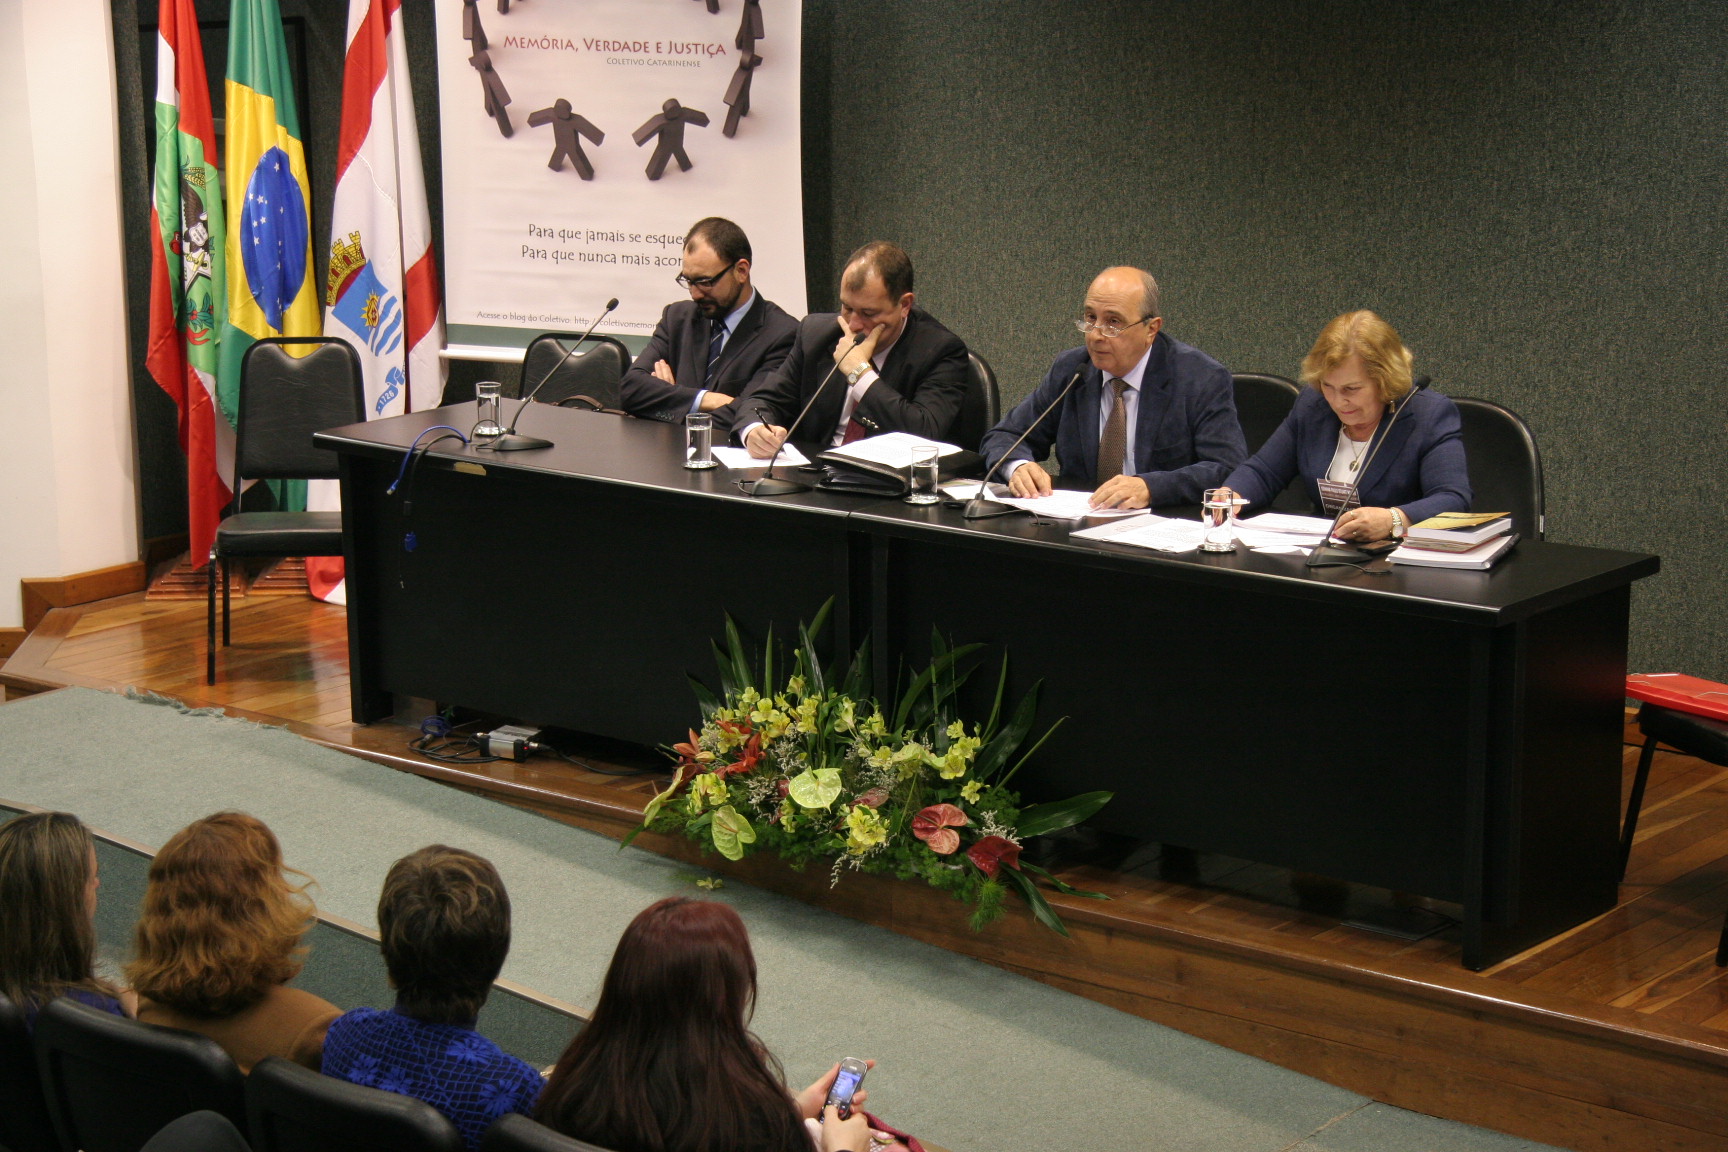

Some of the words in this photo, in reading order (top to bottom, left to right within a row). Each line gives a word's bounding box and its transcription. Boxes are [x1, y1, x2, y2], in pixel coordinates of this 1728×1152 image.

[503, 35, 579, 52] MEMÓRIA,
[583, 38, 649, 53] VERDADE
[656, 42, 662, 54] E
[668, 41, 726, 59] JUSTIÇA
[606, 57, 645, 66] COLETIVO
[647, 58, 701, 68] CATARINENSE
[528, 223, 554, 239] Para
[558, 228, 582, 243] que
[585, 228, 625, 244] jamais
[628, 234, 641, 243] se
[521, 245, 547, 260] Para
[551, 250, 574, 264] que
[579, 252, 617, 265] nunca
[621, 253, 650, 266] mais
[476, 311, 501, 319] Acesse
[509, 312, 526, 323] blog
[528, 313, 537, 322] do
[379, 390, 395, 405] 1726
